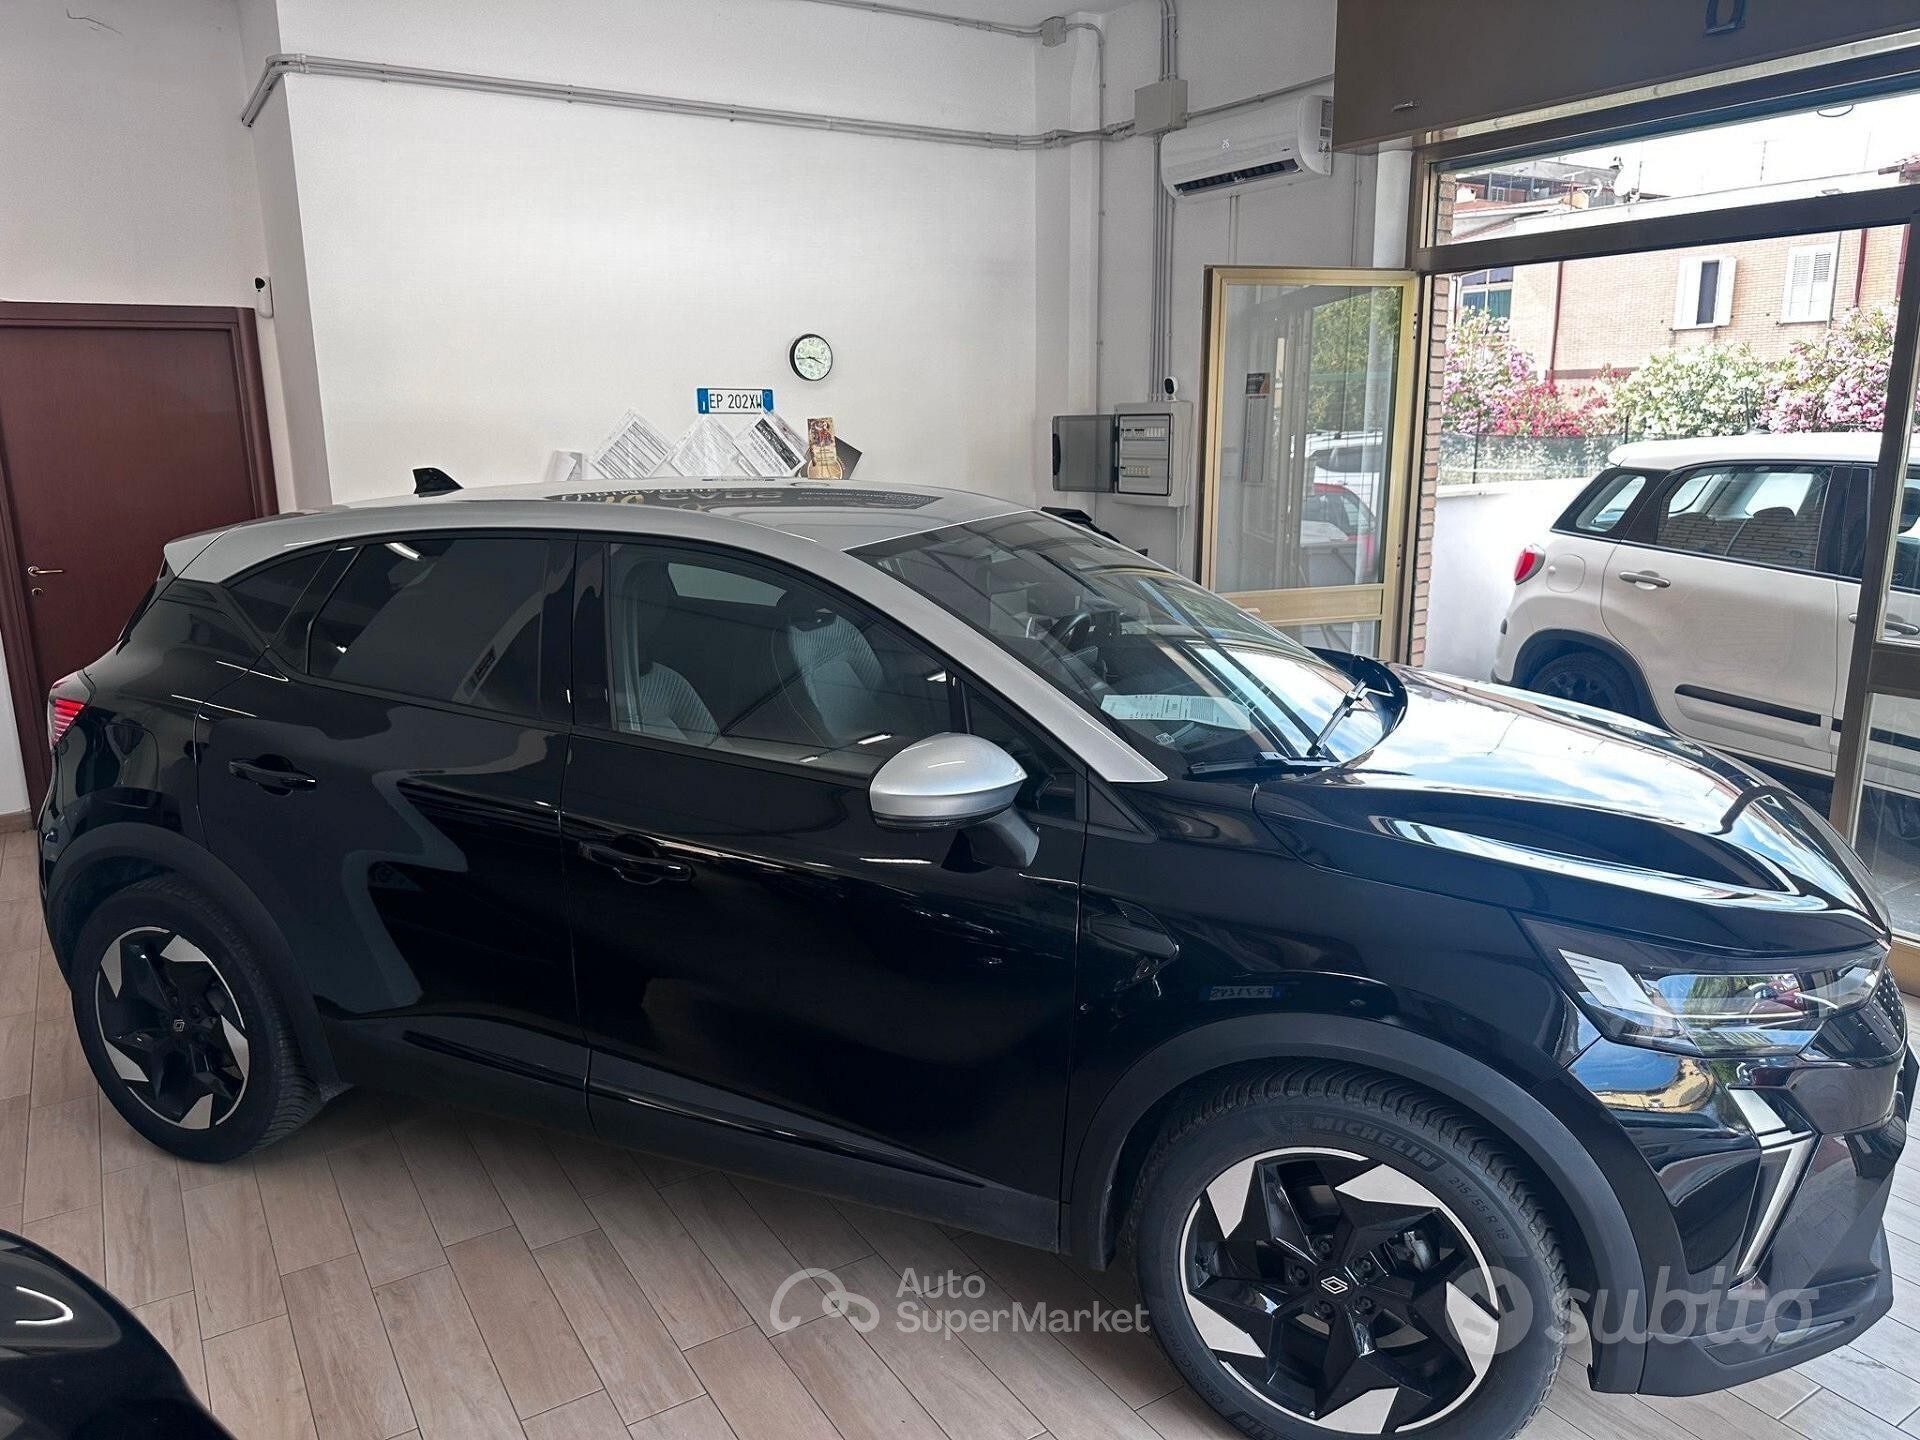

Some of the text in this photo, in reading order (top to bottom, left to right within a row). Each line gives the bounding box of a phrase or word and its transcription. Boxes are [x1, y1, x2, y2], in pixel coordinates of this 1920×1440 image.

[709, 394, 762, 409] EP 202XW
[1311, 1115, 1438, 1168] MICHELIN
